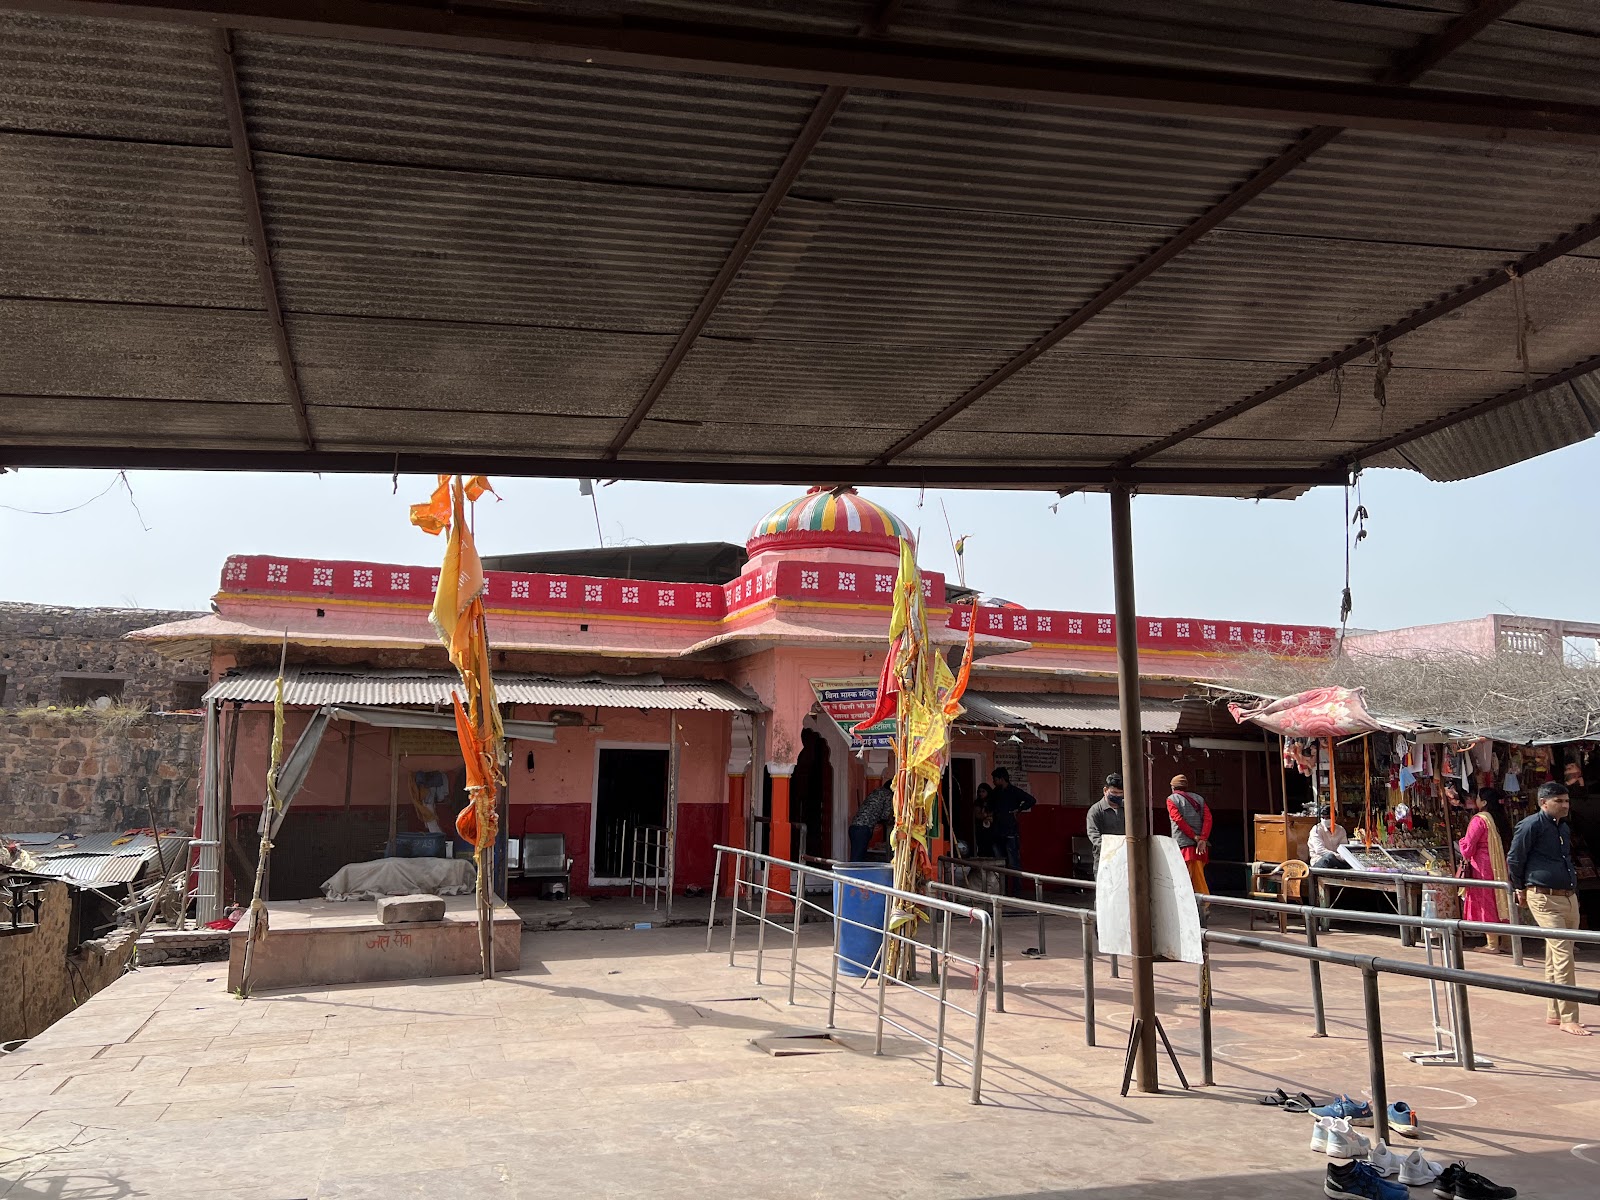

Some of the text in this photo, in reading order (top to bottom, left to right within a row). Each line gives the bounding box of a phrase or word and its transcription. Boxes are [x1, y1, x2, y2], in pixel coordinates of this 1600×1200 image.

[825, 690, 839, 699] बिना
[840, 691, 858, 699] मास्क
[839, 702, 855, 710] किसी
[856, 701, 865, 709] भी
[366, 930, 412, 952] जल सेवा
